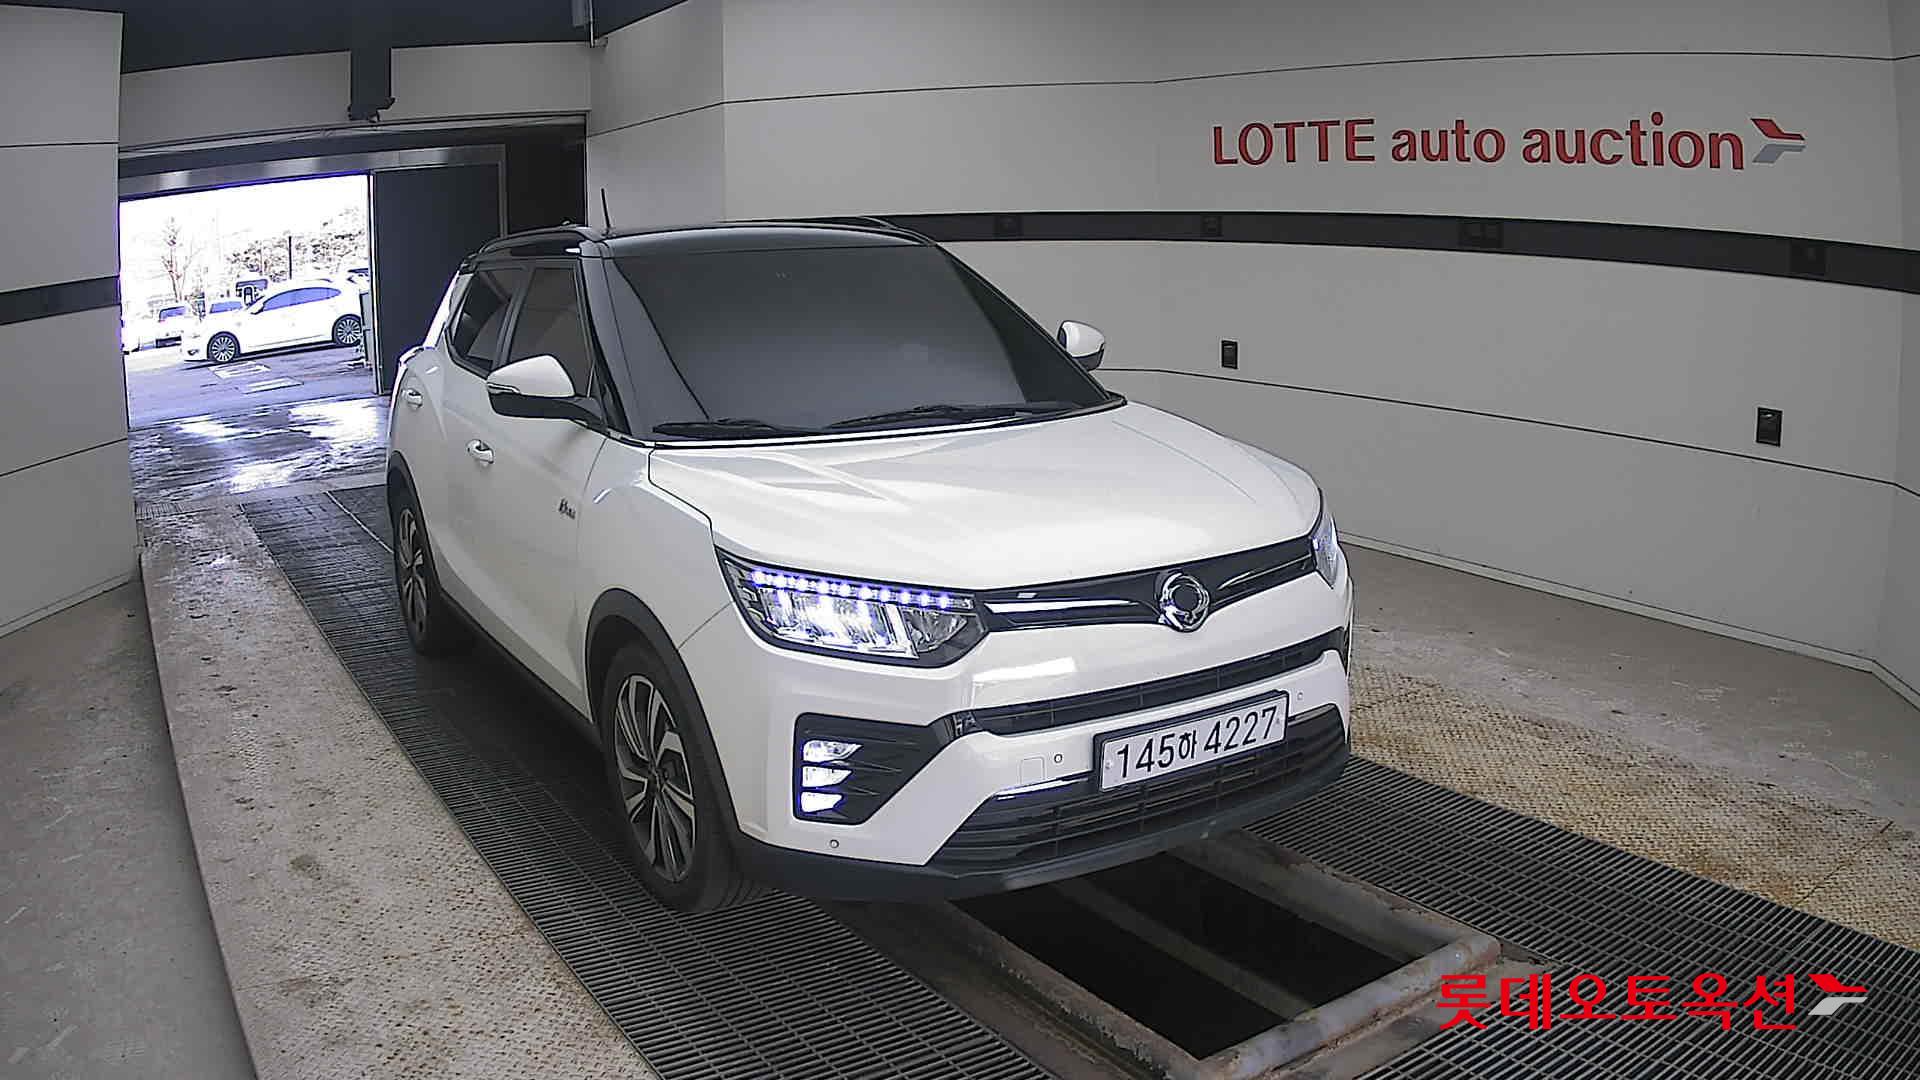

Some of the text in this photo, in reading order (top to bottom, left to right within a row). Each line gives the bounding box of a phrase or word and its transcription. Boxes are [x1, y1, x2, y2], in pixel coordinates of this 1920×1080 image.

[1213, 112, 1744, 170] LOTTE auto auction
[1117, 706, 1277, 778] 145하 4227
